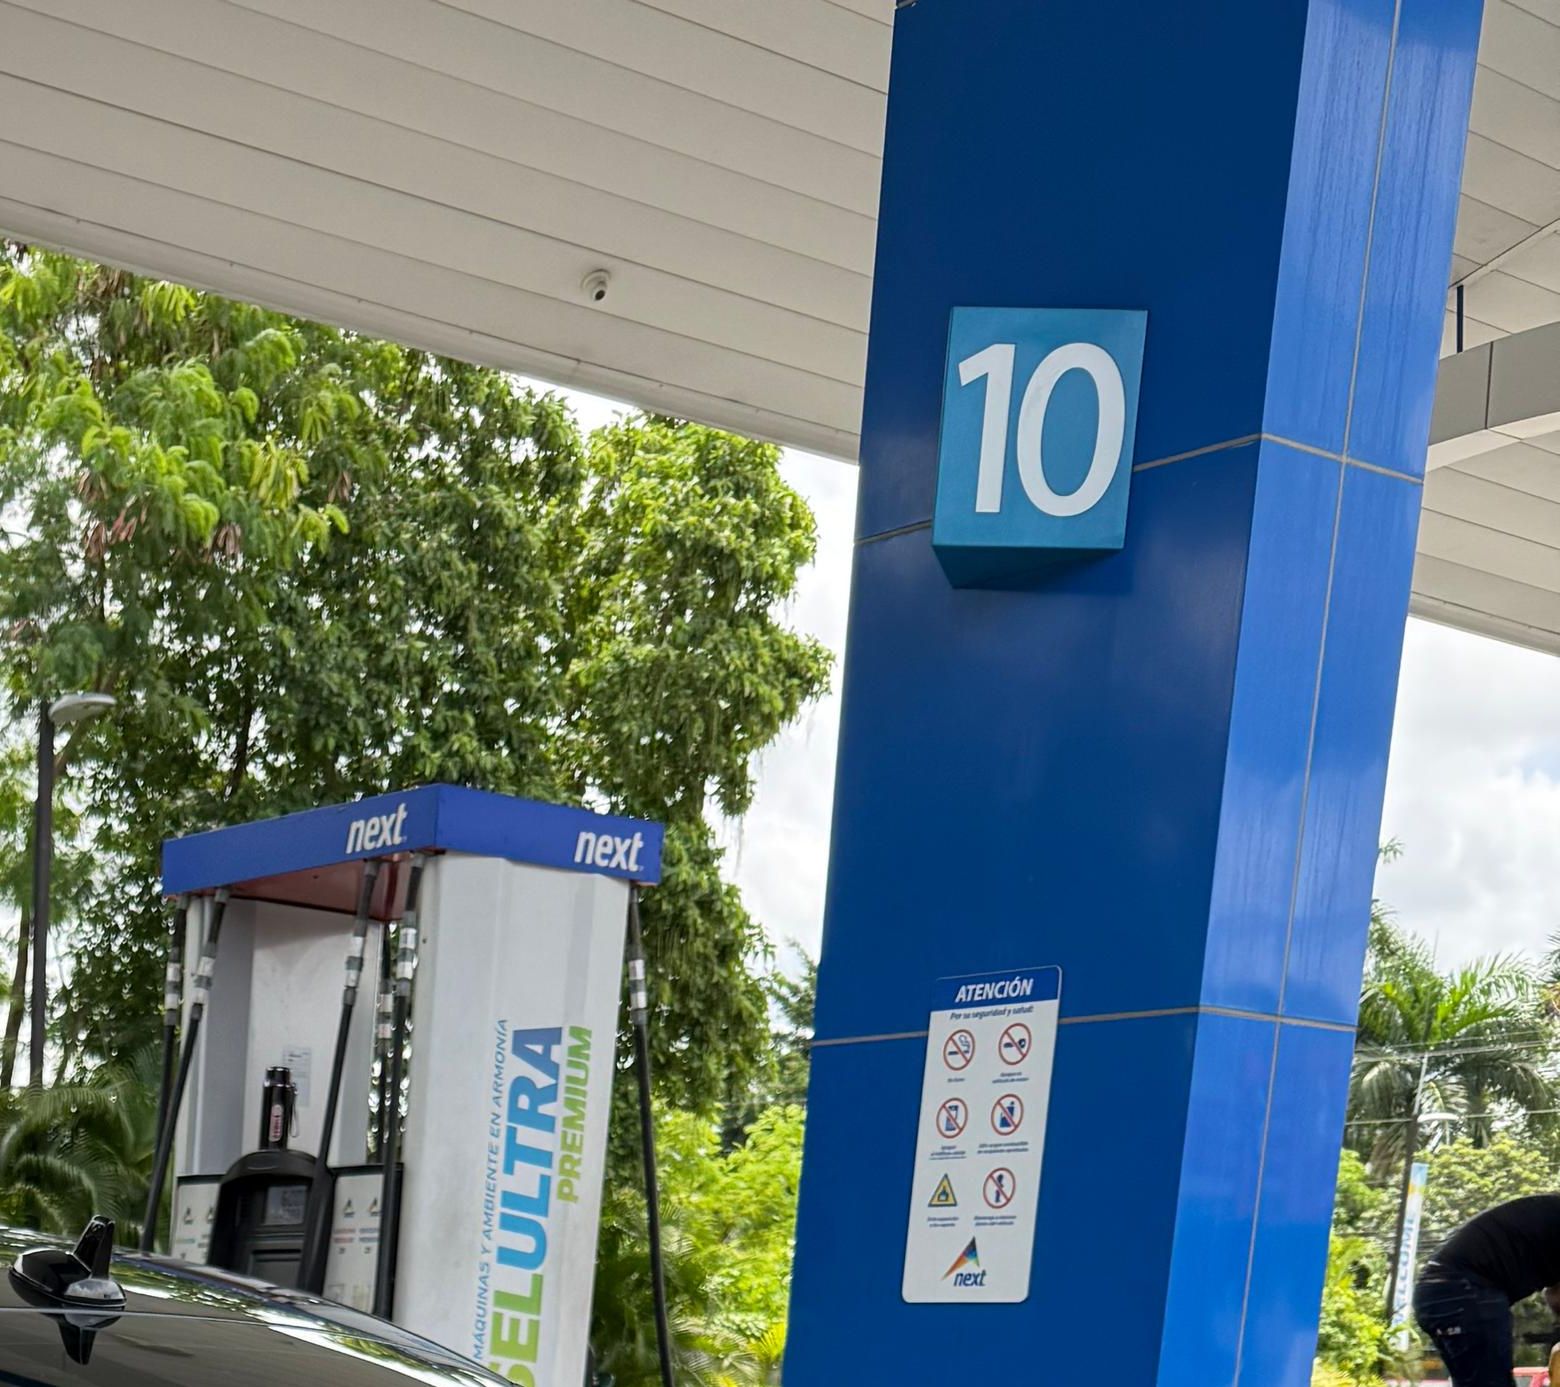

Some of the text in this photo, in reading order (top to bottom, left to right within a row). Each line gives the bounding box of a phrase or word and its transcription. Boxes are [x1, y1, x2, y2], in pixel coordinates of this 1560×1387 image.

[958, 342, 1126, 517] 10
[345, 803, 407, 854] next
[574, 831, 644, 872] next
[954, 976, 1034, 1003] ATENCIÓN
[492, 1019, 508, 1108] ARMONÍA
[490, 1112, 501, 1139] EN
[556, 1025, 592, 1203] PREMIUM
[482, 1141, 500, 1241] AMBIENTE
[472, 1262, 490, 1360] MÁQUINAS
[953, 1269, 987, 1287] next
